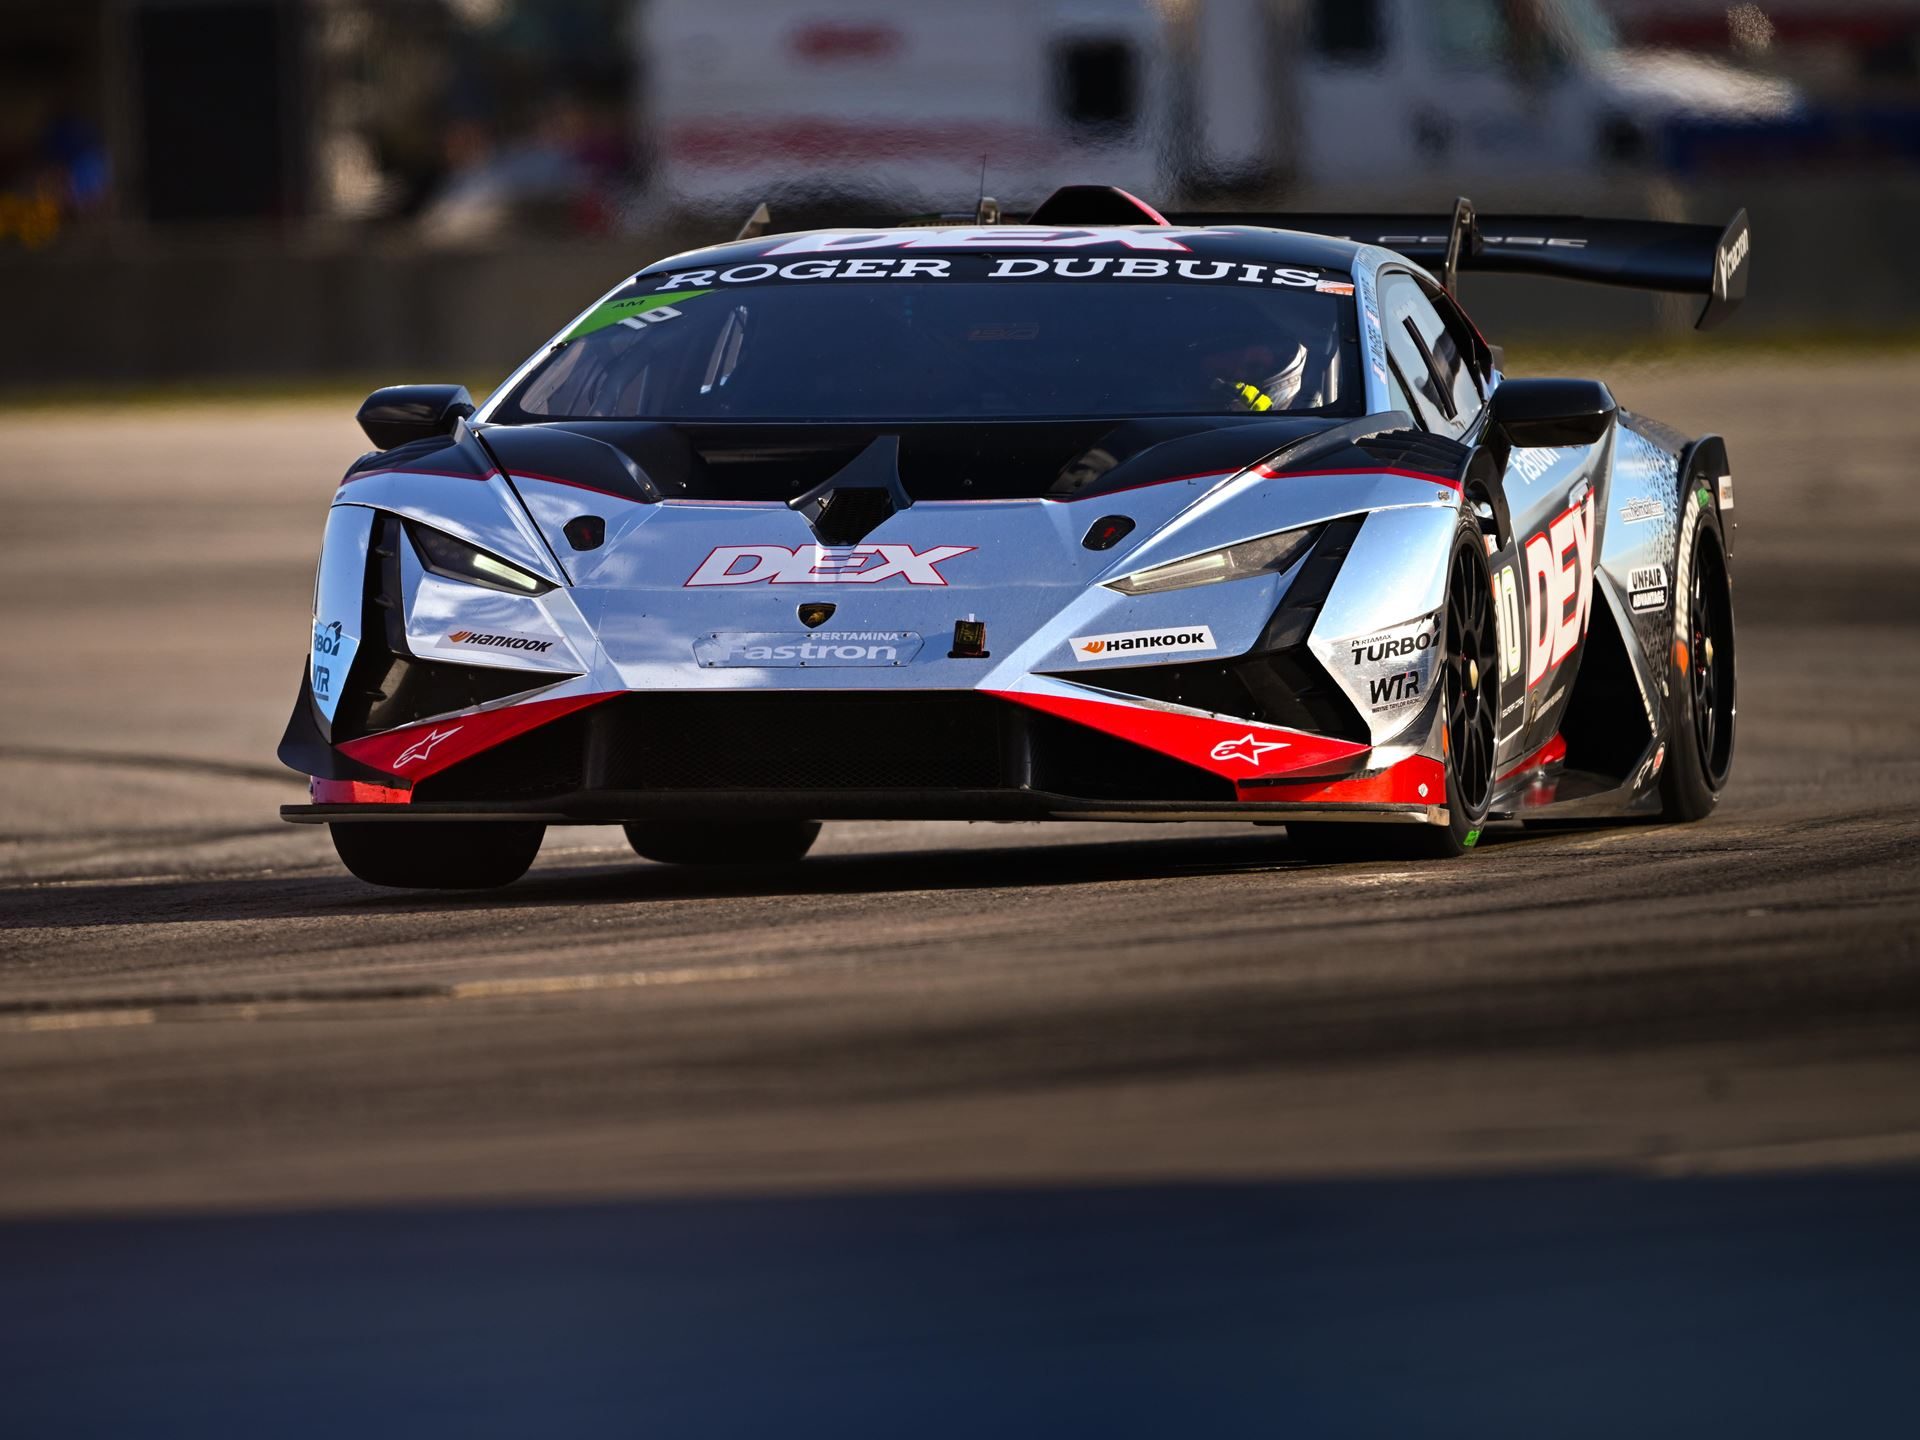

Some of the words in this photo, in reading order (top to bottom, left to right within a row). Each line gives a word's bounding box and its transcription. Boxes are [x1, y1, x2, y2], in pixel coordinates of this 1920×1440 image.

[761, 228, 1241, 256] DEX
[655, 259, 952, 290] ROGER
[987, 258, 1320, 287] DUBUIS
[612, 299, 646, 309] AM
[617, 306, 683, 330] 10
[682, 544, 979, 587] DEX
[1632, 567, 1663, 589] UNFAIR
[1525, 486, 1595, 692] DEX
[1632, 589, 1665, 608] ADVANTAGE
[811, 632, 900, 641] PERTAMINA
[1351, 632, 1431, 666] TURBO
[1369, 670, 1419, 704] WTR
